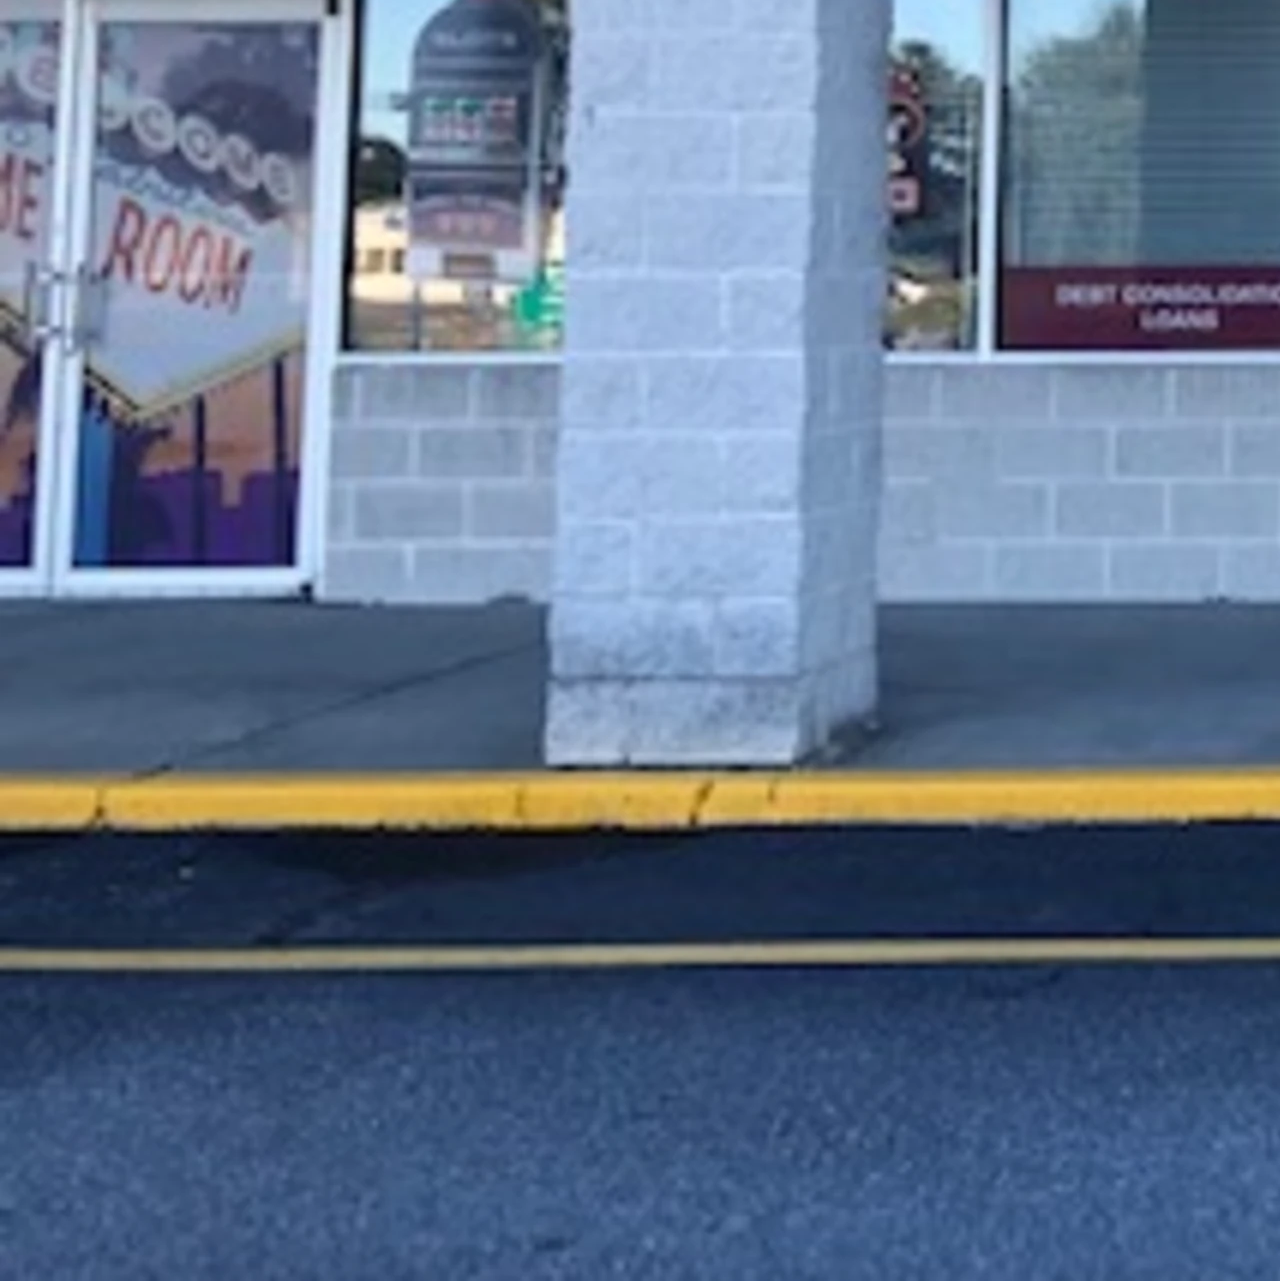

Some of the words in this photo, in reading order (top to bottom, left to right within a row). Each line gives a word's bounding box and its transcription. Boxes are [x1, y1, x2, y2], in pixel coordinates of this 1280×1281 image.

[101, 196, 251, 315] ROOM
[1056, 284, 1117, 305] DEBT
[1140, 309, 1219, 330] LOANS
